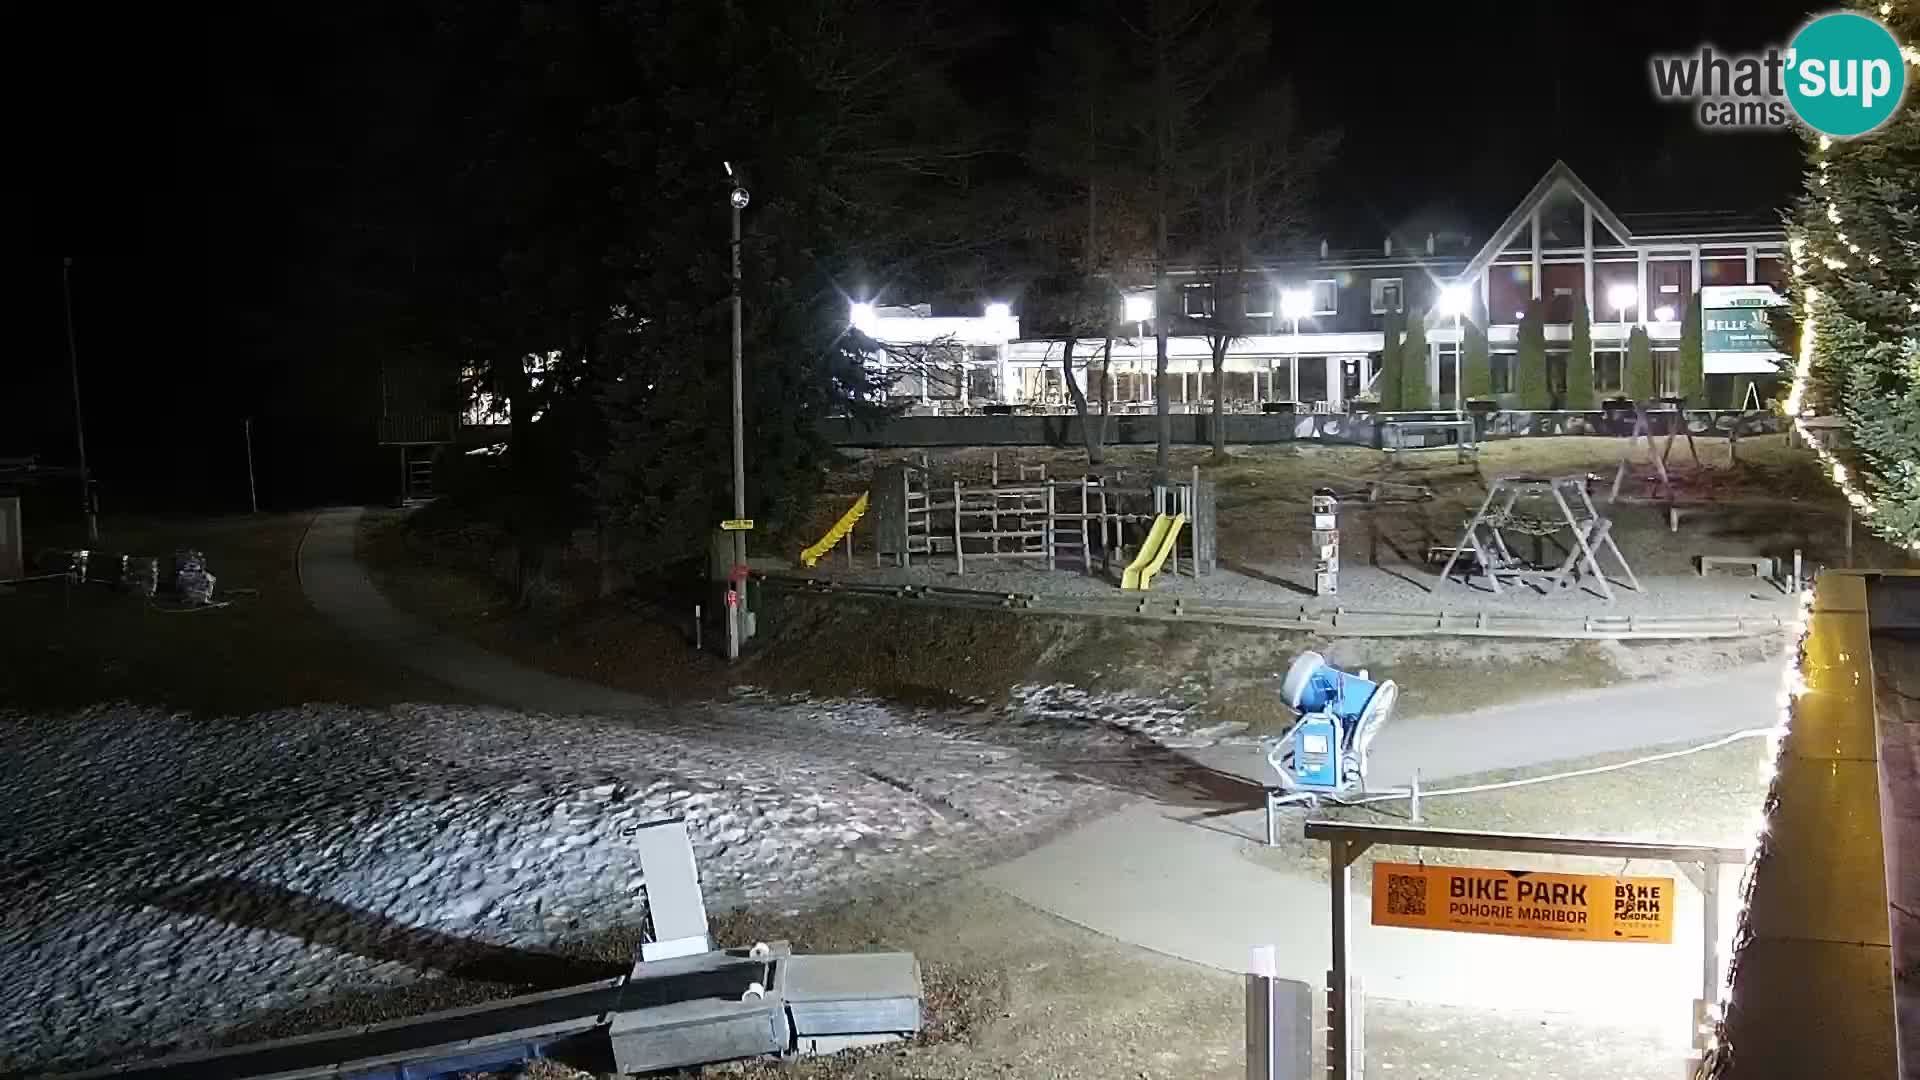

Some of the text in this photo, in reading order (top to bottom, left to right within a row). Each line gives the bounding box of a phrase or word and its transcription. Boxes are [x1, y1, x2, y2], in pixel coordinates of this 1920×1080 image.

[1450, 876, 1588, 906] BIKE PARK
[1518, 905, 1588, 924] MARIBOR
